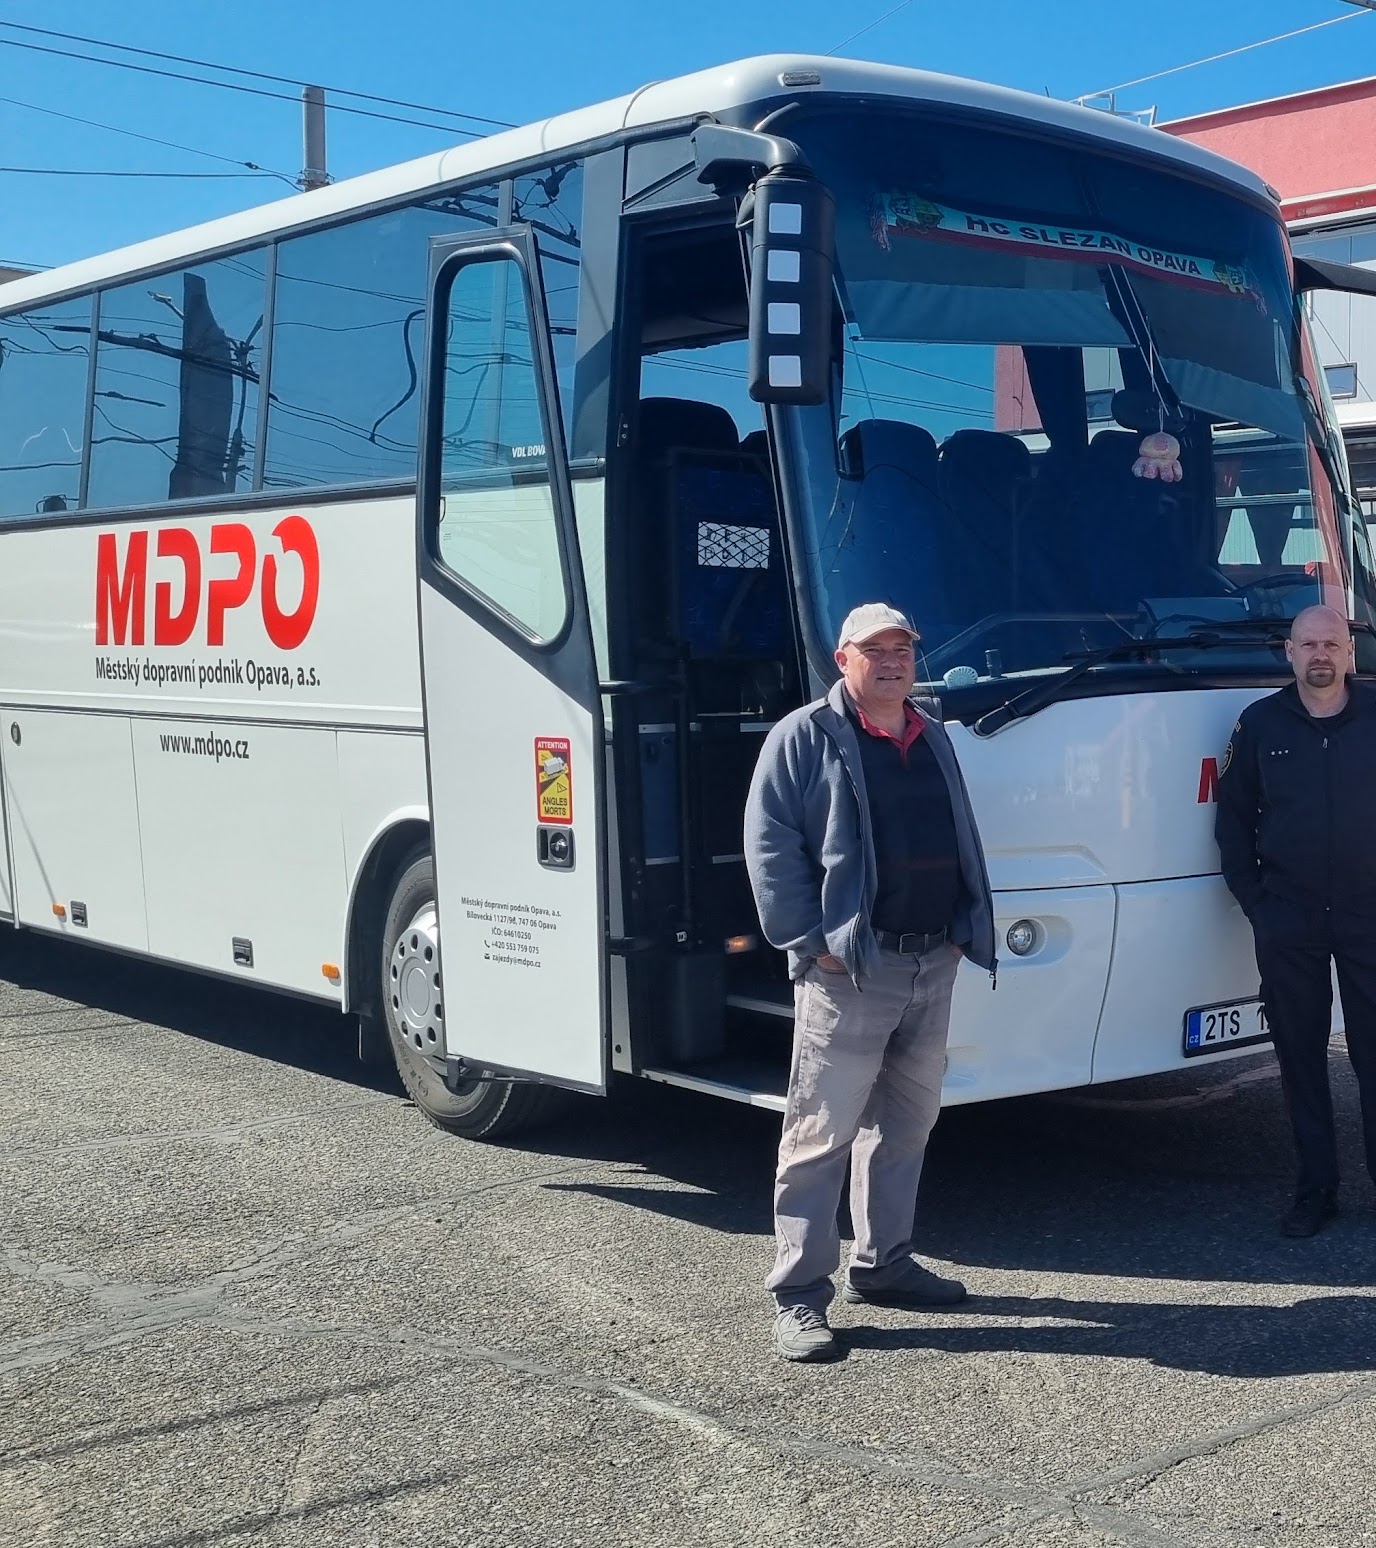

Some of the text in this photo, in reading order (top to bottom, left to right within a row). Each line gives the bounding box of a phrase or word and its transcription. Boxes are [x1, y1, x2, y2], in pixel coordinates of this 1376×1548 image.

[965, 215, 1202, 275] HC SLEZAN OPAVA
[511, 446, 527, 458] VDL
[95, 515, 320, 651] MDPO
[96, 656, 321, 691] Městský dopravní podnik Opava, a.s.
[159, 730, 250, 763] www.mdpo.cz
[537, 741, 568, 750] ATTENTION
[542, 796, 568, 807] ANGLES
[544, 806, 567, 816] MORTS
[461, 896, 484, 908] Městský
[484, 899, 509, 910] dopravní
[510, 903, 530, 913] podnik
[531, 905, 551, 916] Opava,
[518, 917, 529, 926] 747
[538, 920, 557, 930] Opava
[491, 940, 505, 950] +420
[506, 942, 516, 951] 553
[528, 945, 539, 955] 075
[492, 953, 542, 968] zajezdy@mdpo.cz
[1205, 1010, 1240, 1041] 2TS
[1189, 1034, 1199, 1044] CZ
